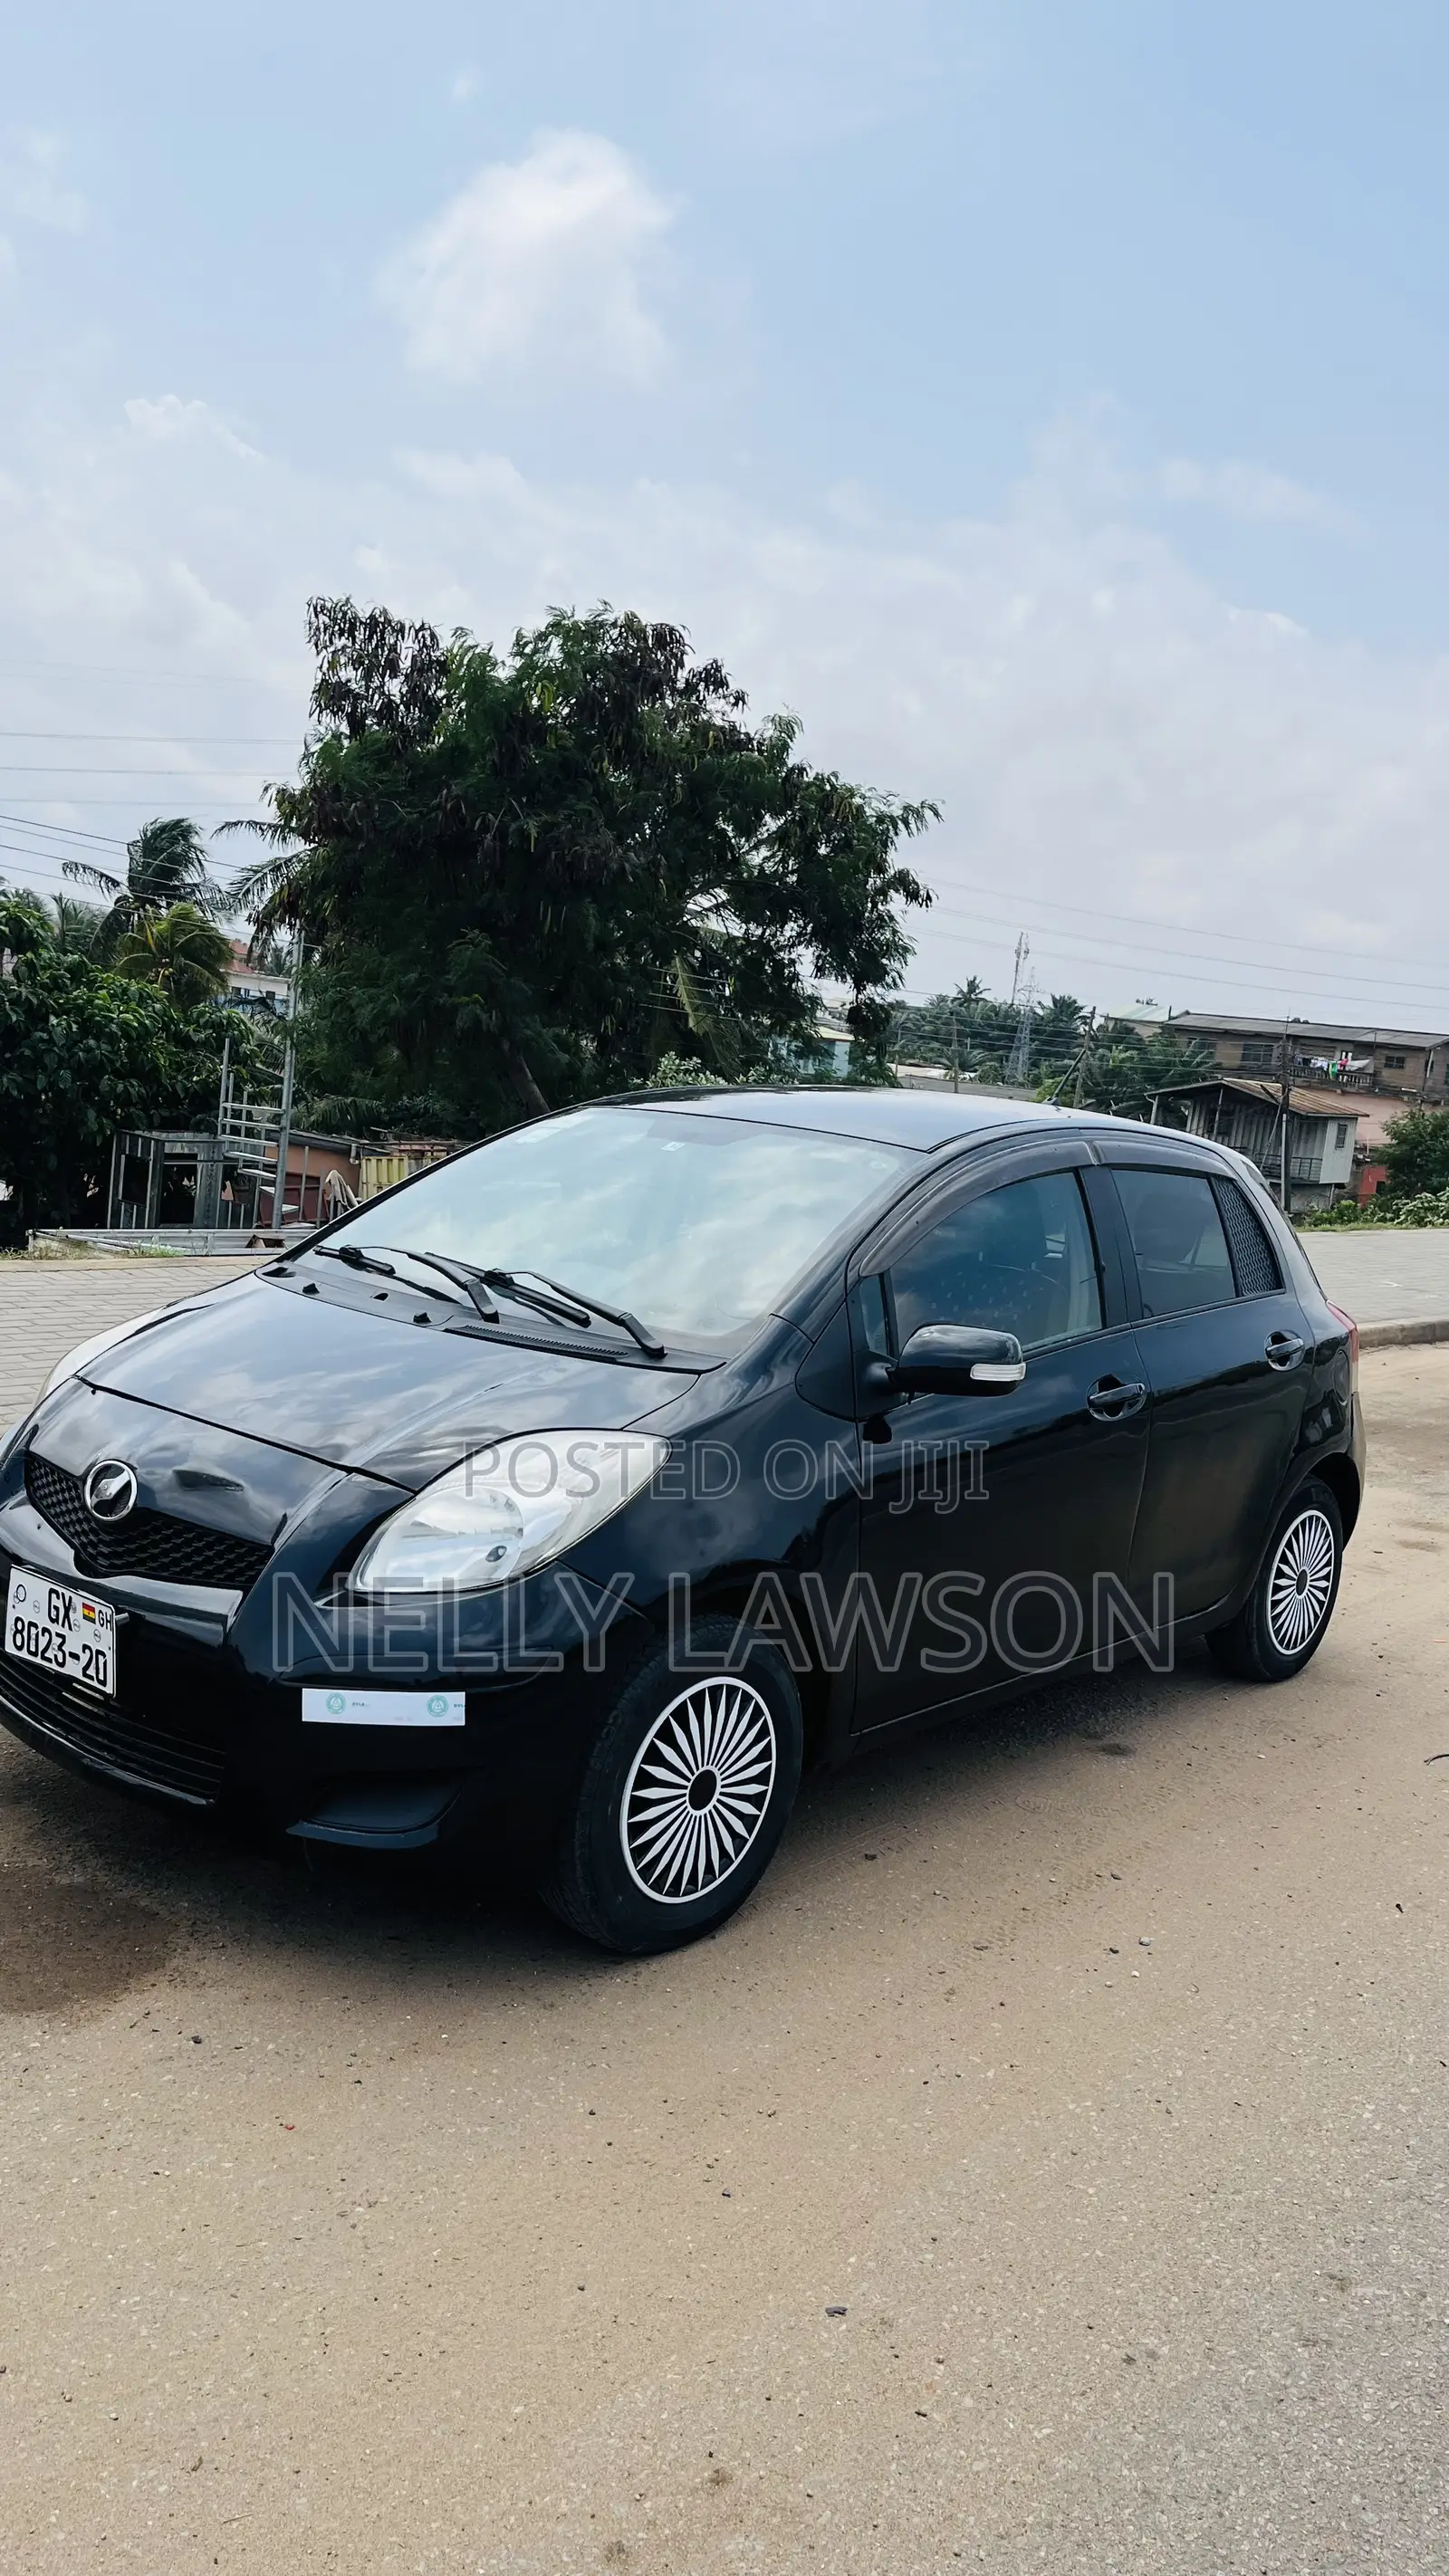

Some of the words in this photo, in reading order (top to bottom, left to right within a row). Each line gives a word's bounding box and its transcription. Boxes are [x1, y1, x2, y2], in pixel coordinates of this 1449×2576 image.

[48, 1587, 73, 1632] GX
[98, 1609, 112, 1632] GH
[13, 1616, 107, 1687] 8023-20
